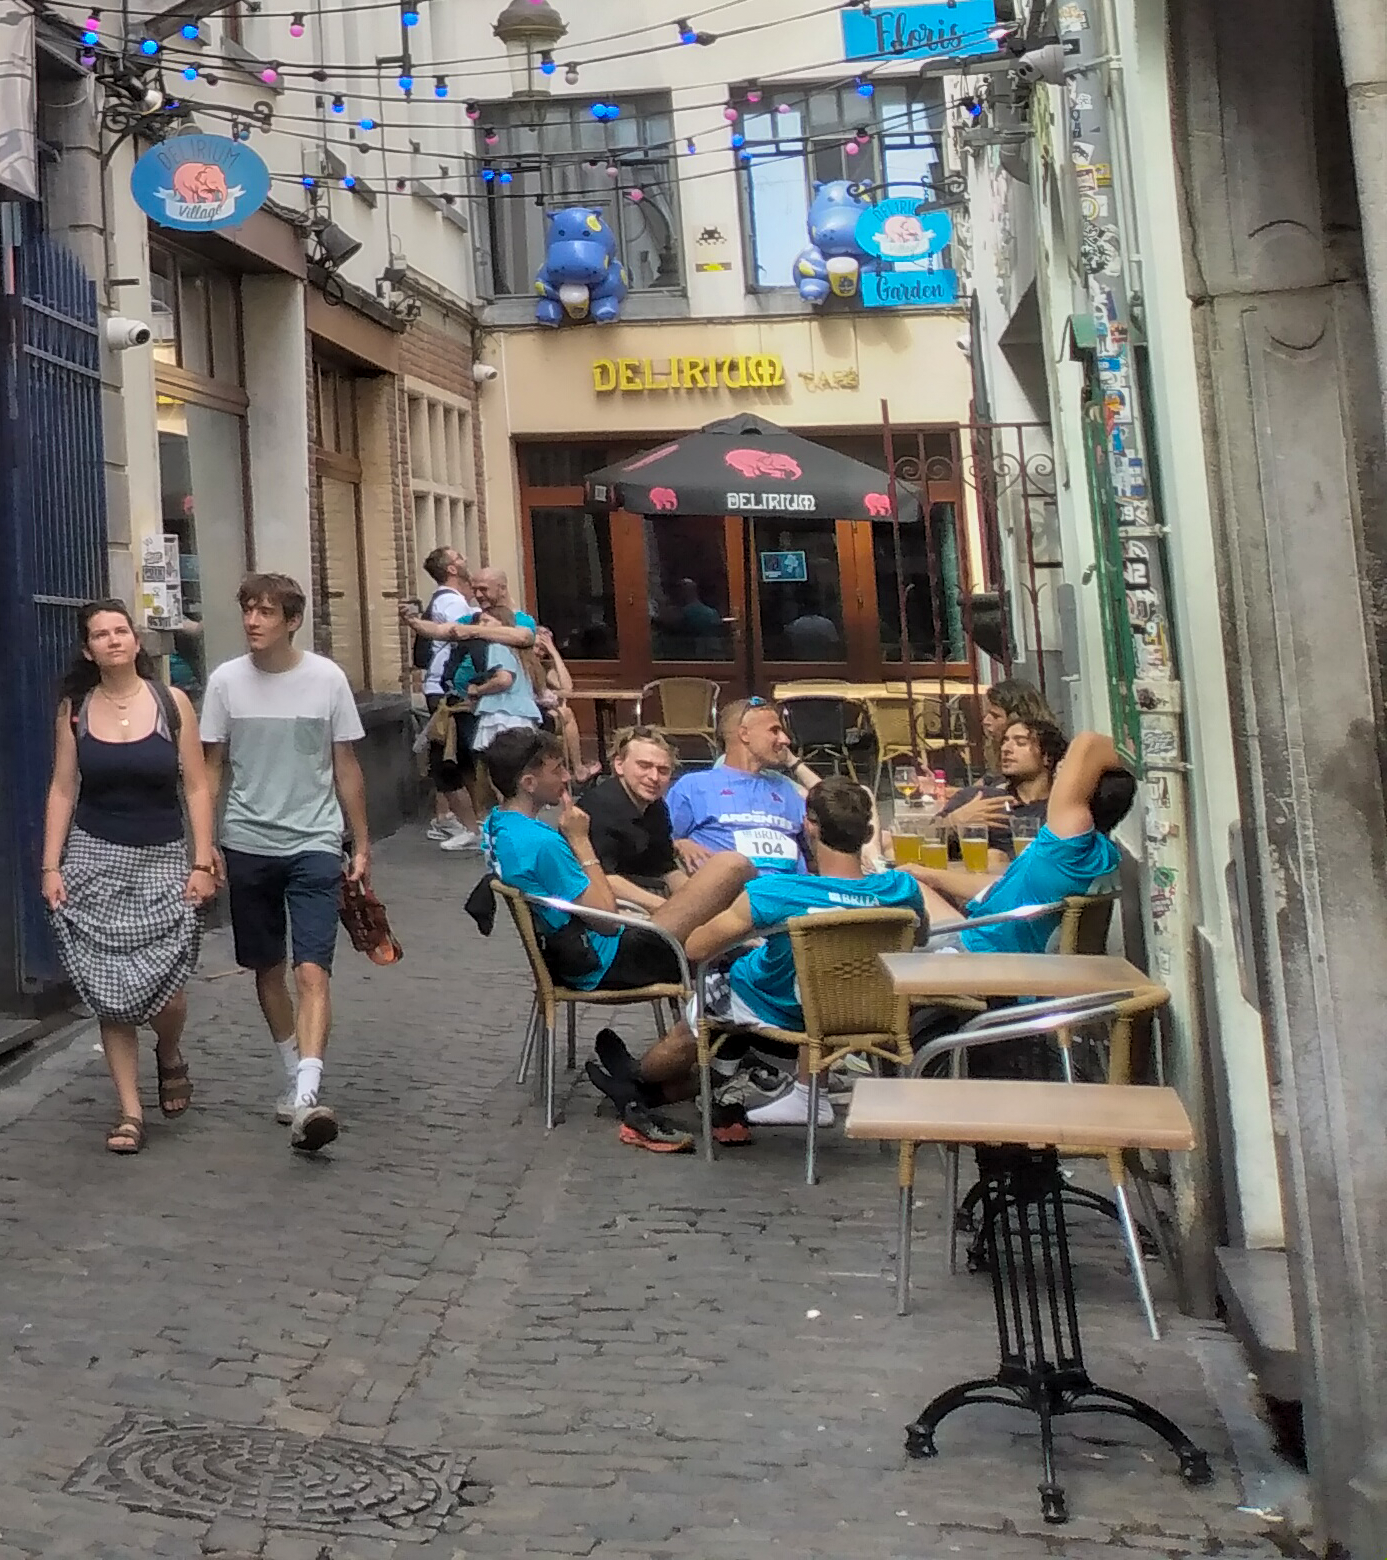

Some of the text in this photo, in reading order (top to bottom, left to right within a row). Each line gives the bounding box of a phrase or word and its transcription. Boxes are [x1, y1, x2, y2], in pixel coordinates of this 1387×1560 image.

[869, 11, 969, 54] Floris
[157, 138, 240, 171] DELIRIUM
[875, 275, 945, 302] Garden
[593, 354, 786, 392] DELIRIUM
[726, 492, 817, 512] DELIRIUM
[752, 841, 784, 856] 104
[842, 893, 881, 907] BRITA
